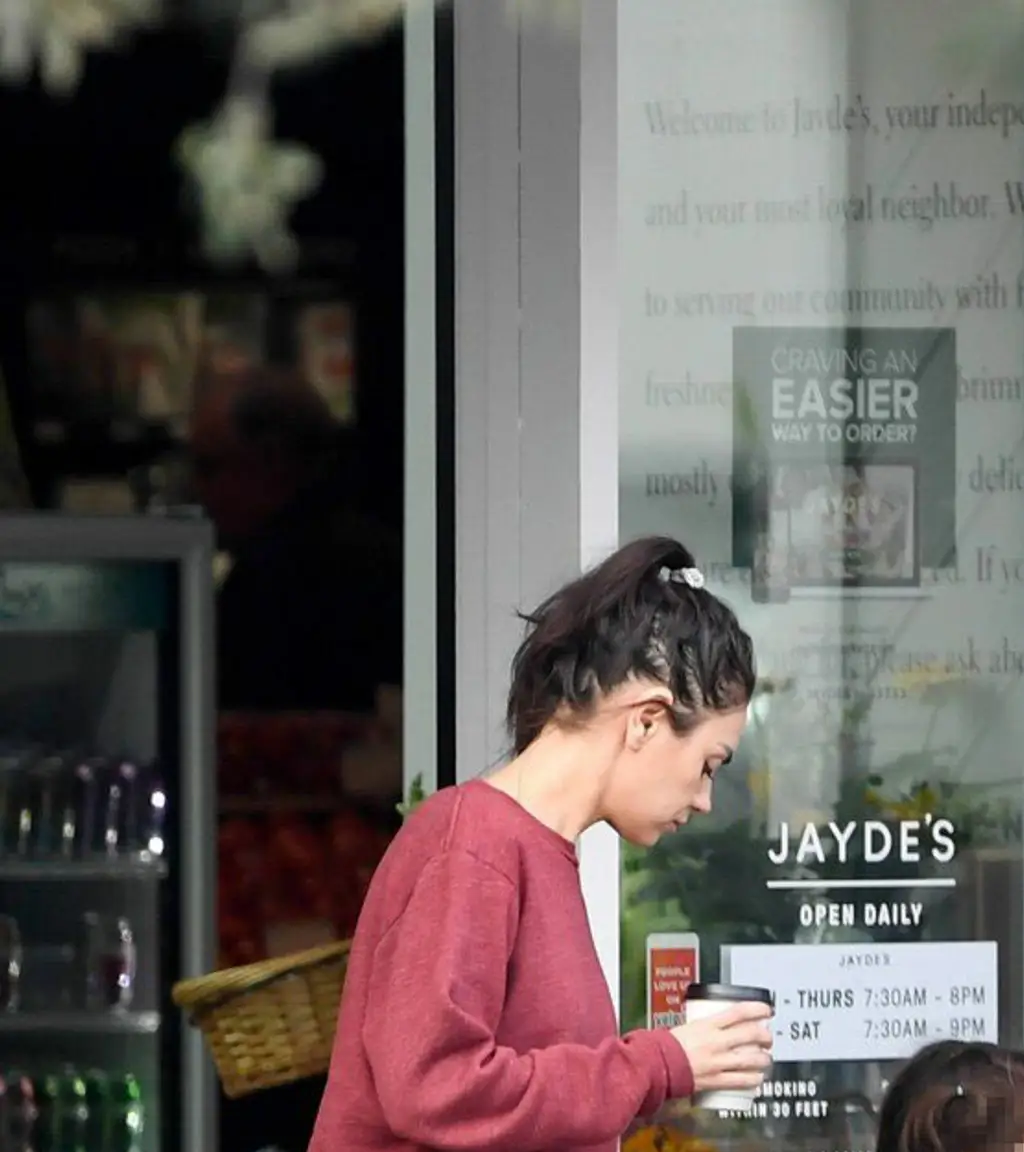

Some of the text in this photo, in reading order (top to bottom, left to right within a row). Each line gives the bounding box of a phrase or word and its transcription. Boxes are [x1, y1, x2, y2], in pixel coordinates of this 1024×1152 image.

[886, 103, 938, 142] your
[645, 185, 689, 226] and
[694, 201, 746, 237] your
[881, 181, 997, 232] neighbor.
[644, 286, 668, 317] to
[762, 288, 804, 314] our
[810, 277, 945, 322] community
[956, 270, 1008, 310] with
[771, 348, 917, 375] CRAVING AN
[772, 378, 919, 419] EASIER
[772, 422, 918, 442] WAY TO ORDER?
[645, 456, 718, 508] mostly
[767, 813, 956, 865] JAYDE'S
[799, 902, 923, 927] OPEN DAILY
[797, 989, 855, 1009] THURS
[863, 987, 927, 1008] 7:30AM
[949, 986, 986, 1006] 8PM
[790, 1020, 821, 1041] SAT
[863, 1019, 927, 1039] 7:30AM
[949, 1018, 986, 1038] 9PM
[772, 1100, 791, 1119] 30
[794, 1099, 829, 1118] FEET
